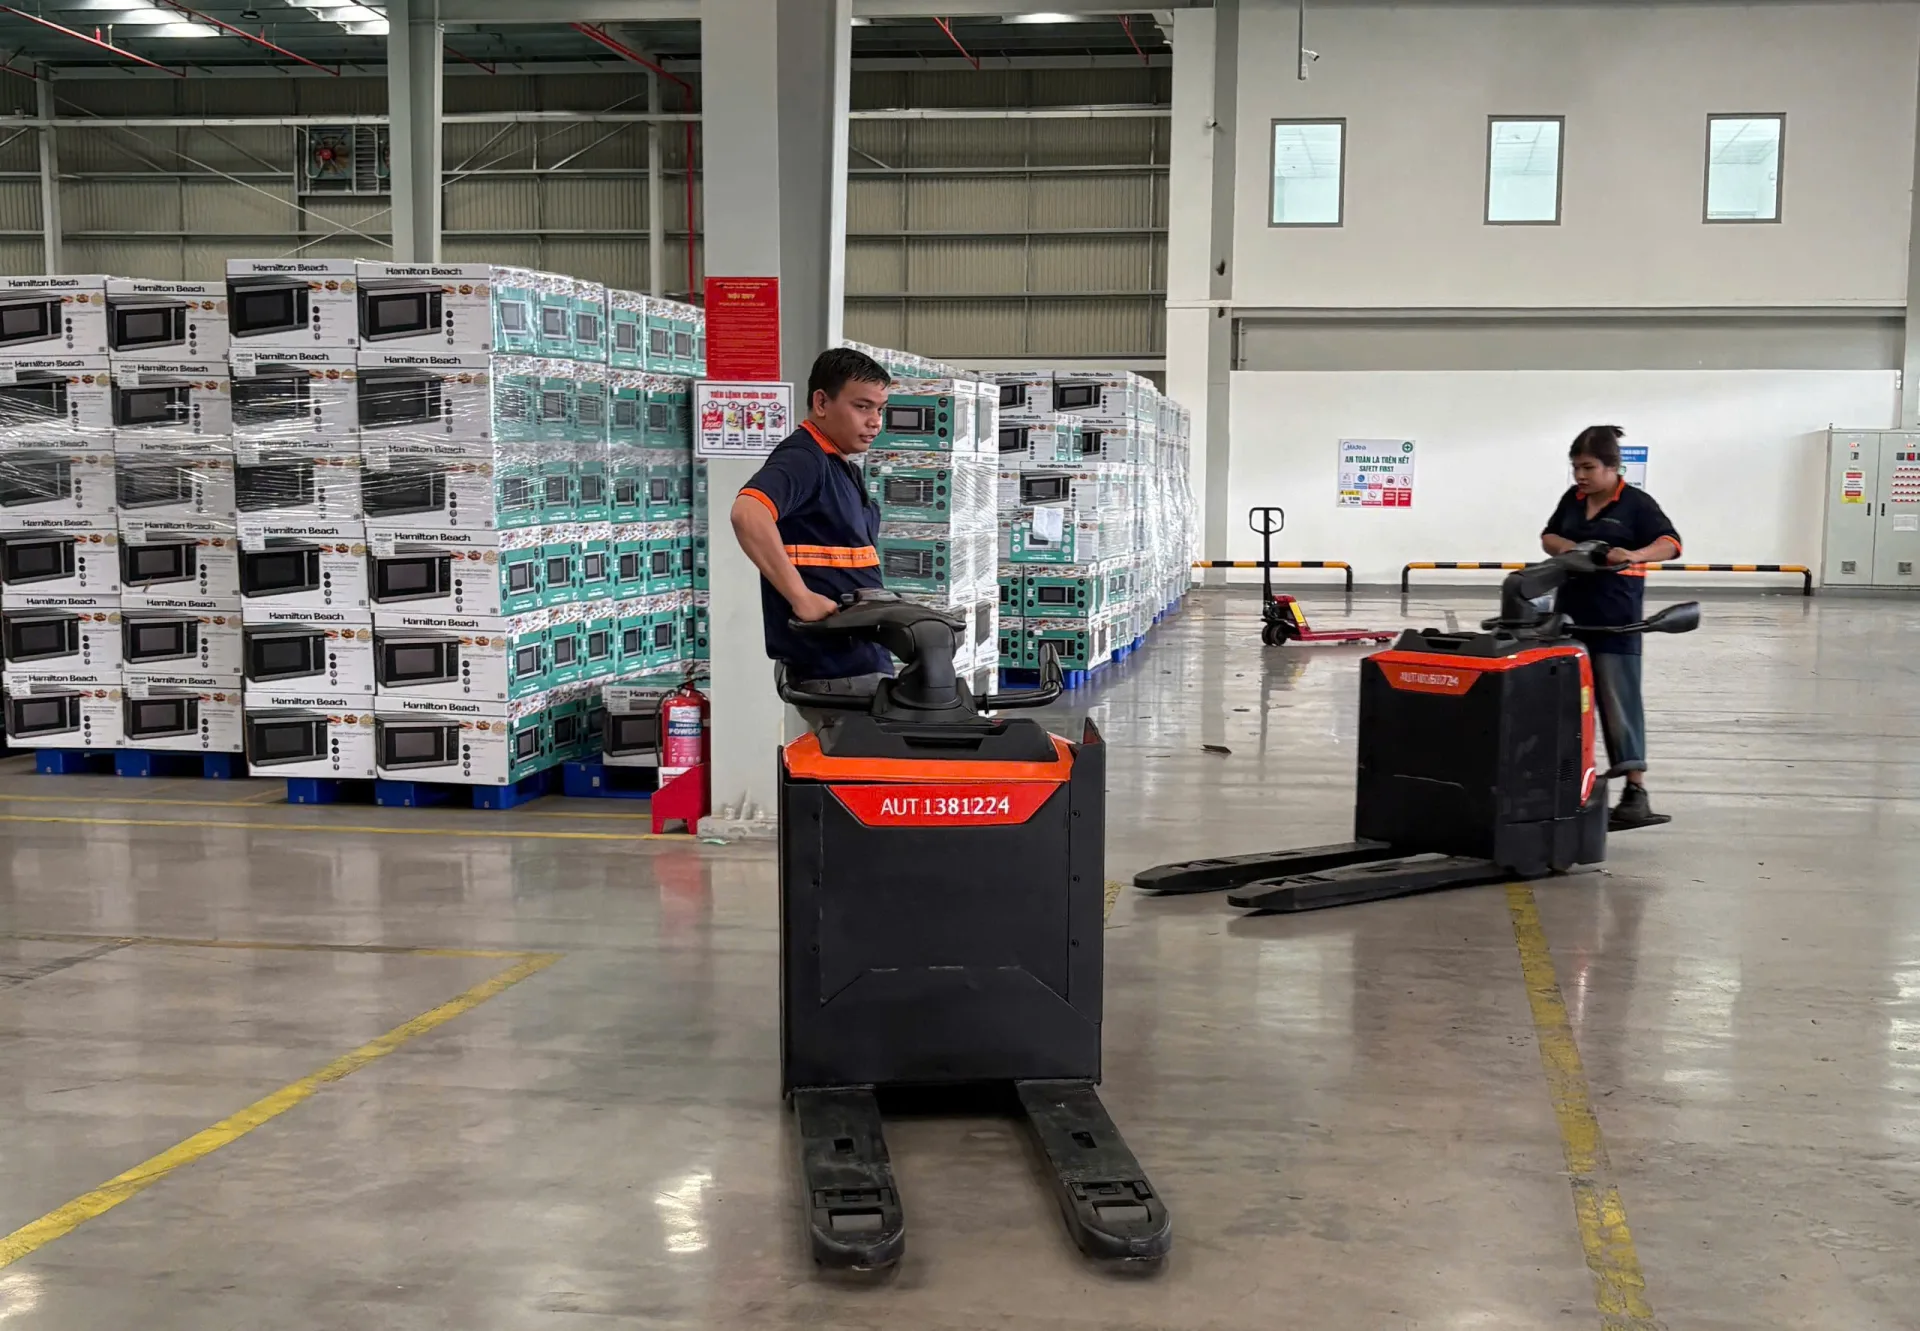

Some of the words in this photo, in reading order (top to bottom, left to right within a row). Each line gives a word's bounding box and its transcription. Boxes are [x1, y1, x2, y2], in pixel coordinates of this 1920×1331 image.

[386, 267, 430, 275] Hamilton
[432, 267, 463, 275] Beach
[8, 280, 48, 288] Hamilton
[50, 279, 79, 287] Beach
[133, 284, 174, 293] Hamilton
[176, 285, 205, 293] Beach
[254, 353, 297, 361] Hamilton
[299, 353, 329, 361] Beach
[384, 356, 428, 364] Hamilton
[430, 357, 461, 365] Beach
[56, 359, 84, 367] Beach
[137, 364, 178, 372] Hamilton
[179, 365, 208, 373] Beach
[388, 445, 432, 453] Hamilton
[434, 446, 466, 454] Beach
[22, 519, 62, 527] Hamilton
[263, 527, 306, 535] Hamilton
[308, 527, 339, 535] Beach
[394, 533, 437, 541] Hamilton
[439, 534, 471, 542] Beach
[26, 597, 67, 605] Hamilton
[68, 597, 96, 605] Beach
[147, 599, 187, 607] Hamilton
[188, 600, 216, 608] Beach
[269, 612, 312, 620] Hamilton
[314, 612, 344, 621] Beach
[403, 618, 446, 626] Hamilton
[448, 619, 479, 628] Beach
[28, 674, 68, 682] Hamilton
[69, 674, 98, 682] Beach
[147, 676, 187, 684] Hamilton
[188, 677, 217, 685] Beach
[271, 697, 314, 706] Hamilton
[316, 698, 347, 707] Beach
[403, 702, 446, 710] Hamilton
[448, 703, 480, 712] Beach
